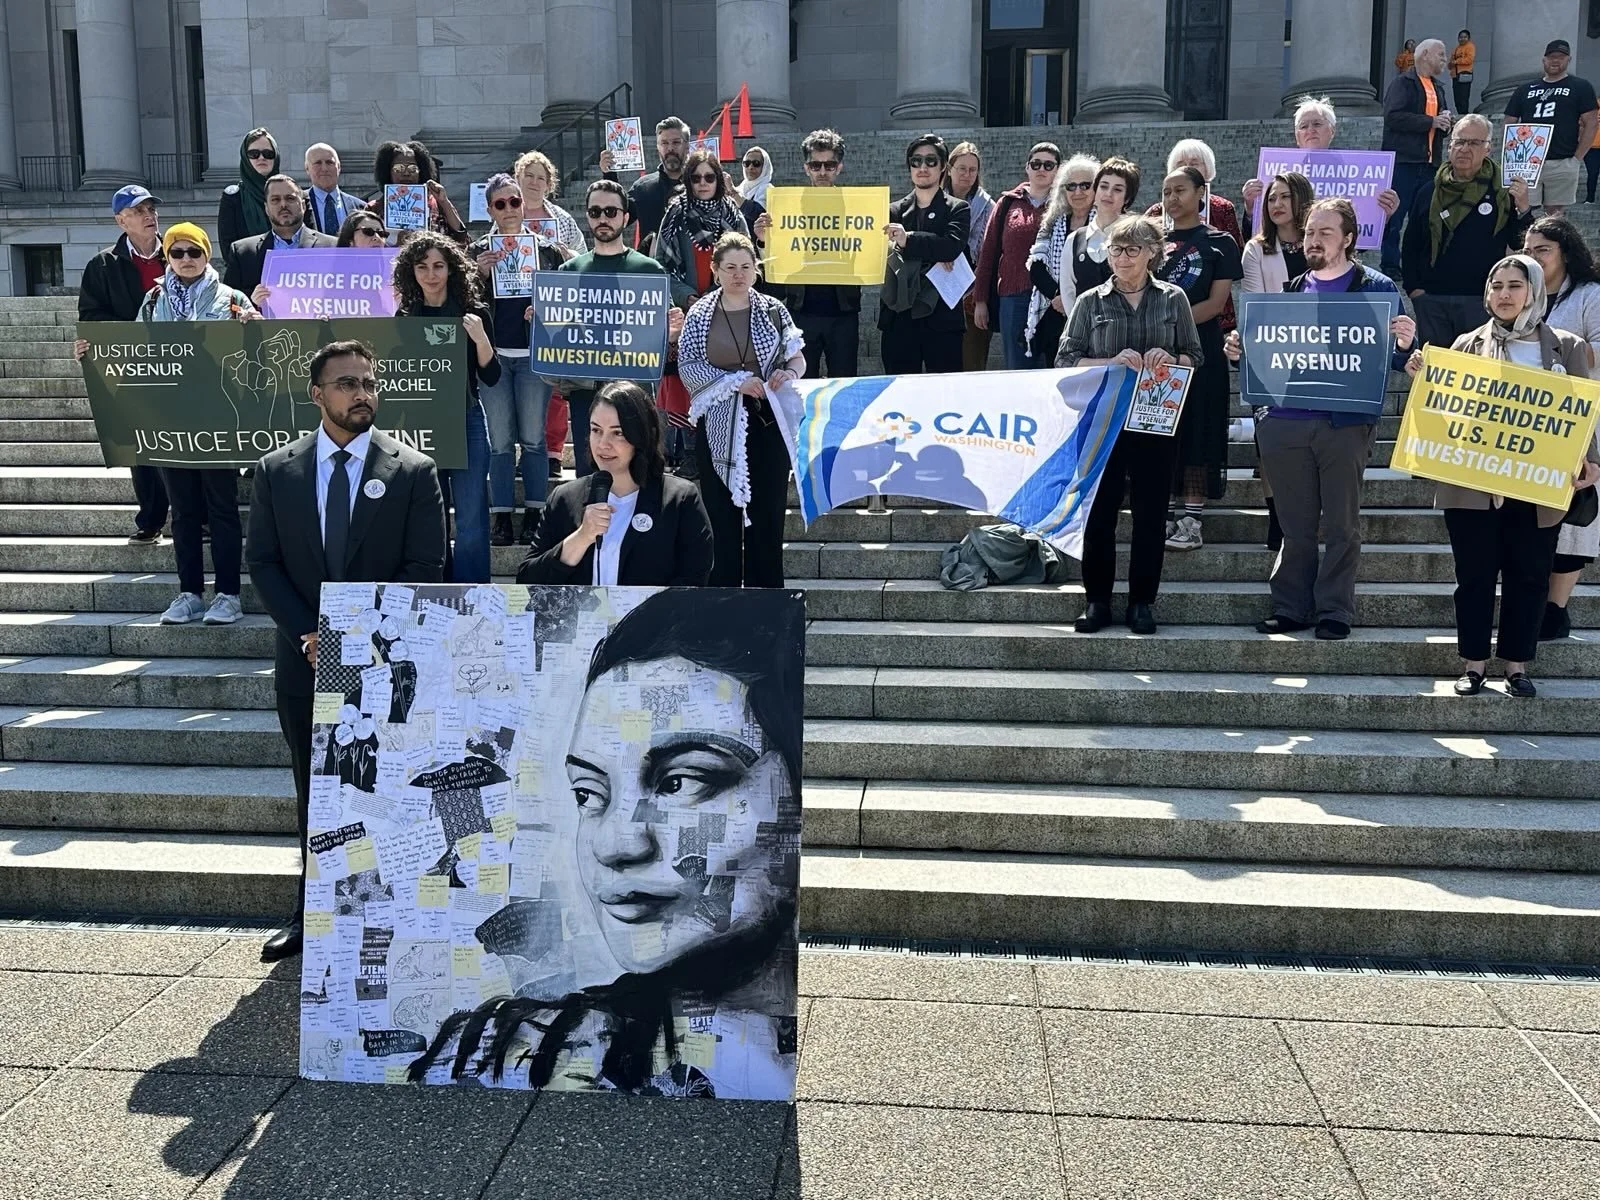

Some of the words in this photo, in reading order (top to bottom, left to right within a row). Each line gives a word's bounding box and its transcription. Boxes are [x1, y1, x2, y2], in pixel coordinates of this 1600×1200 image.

[1533, 102, 1556, 118] 12
[1265, 162, 1288, 176] WE
[1292, 163, 1358, 179] DEMAND
[1363, 165, 1386, 179] AN
[1310, 181, 1378, 197] ENDENT
[780, 215, 840, 230] JUSTICE
[845, 215, 874, 231] FOR
[277, 272, 345, 289] JUSTICE
[350, 274, 383, 290] FOR
[538, 286, 563, 303] WE
[567, 288, 636, 305] DEMAND
[640, 290, 663, 306] AN
[544, 306, 656, 326] INDEPENDENT
[567, 328, 599, 345] U.S.
[604, 330, 633, 346] LED
[1255, 325, 1331, 344] JUSTICE
[1337, 326, 1377, 345] FOR
[93, 343, 158, 361] JUSTICE
[160, 343, 195, 357] FOR
[537, 346, 660, 368] INVESTIGATION
[105, 363, 183, 377] AYSENUR
[420, 359, 452, 373] FOR
[379, 378, 437, 392] RACHEL
[1425, 365, 1457, 387] WE
[1461, 374, 1554, 408] DEMAND
[1558, 395, 1592, 418] AN
[1135, 405, 1160, 414] JUSTICE
[1162, 408, 1175, 416] FOR
[1425, 390, 1576, 438] INDEPENDENT
[933, 412, 1038, 446] CAIR
[1448, 421, 1488, 446] U.S.
[1495, 431, 1535, 455] LED
[136, 429, 232, 454] JUSTICE
[236, 430, 291, 452] FOR
[934, 434, 1036, 456] WASHINGTON
[1404, 435, 1567, 489] INVESTIGATION
[682, 857, 703, 869] WAKE
[686, 867, 697, 877] UP
